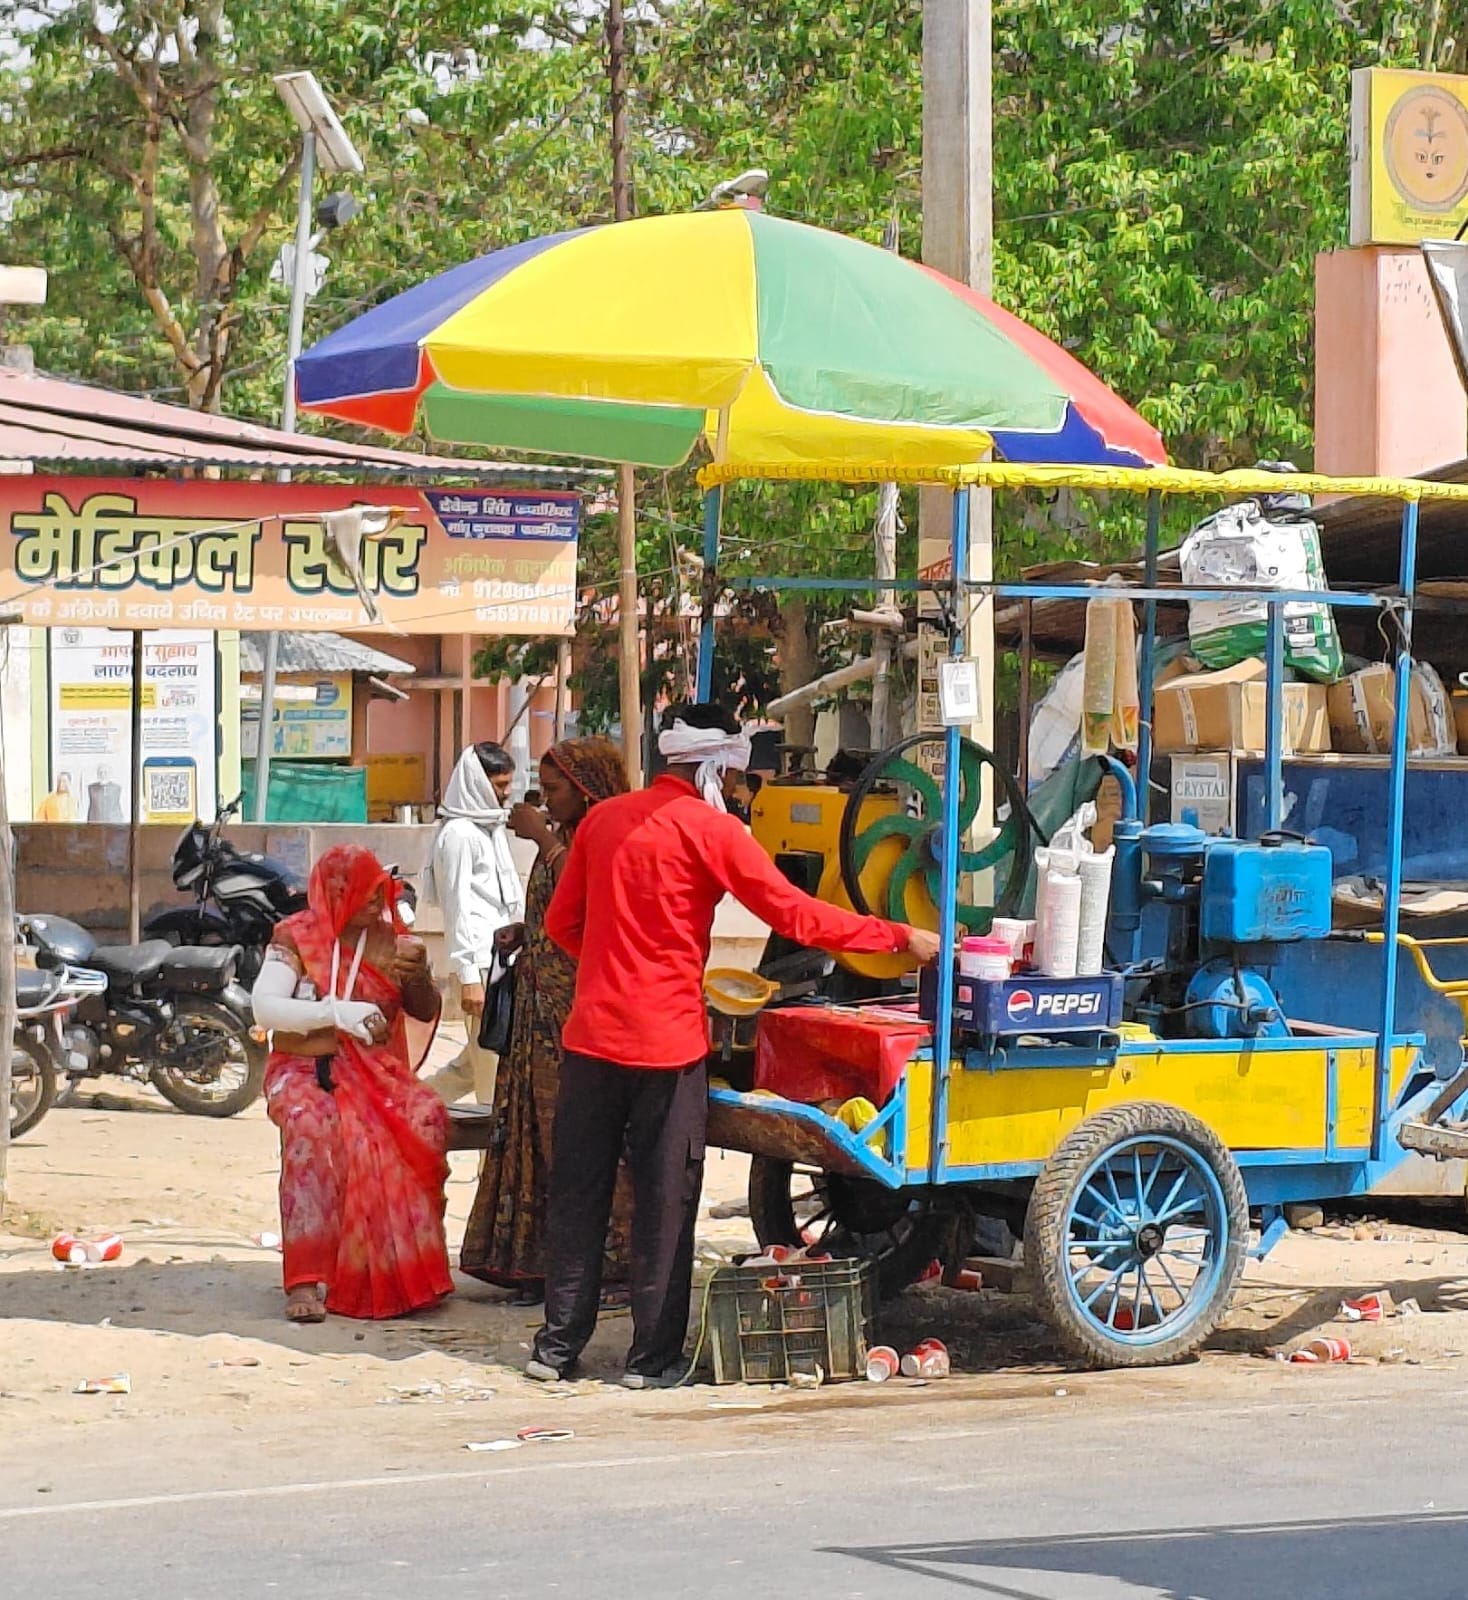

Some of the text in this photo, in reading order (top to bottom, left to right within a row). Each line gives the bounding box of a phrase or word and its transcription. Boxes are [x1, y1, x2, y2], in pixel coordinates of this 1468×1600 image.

[11, 492, 262, 593] मेडिकल
[260, 606, 283, 621] पर
[1175, 780, 1225, 798] CRYSTAL
[1036, 993, 1101, 1015] PEPSI
